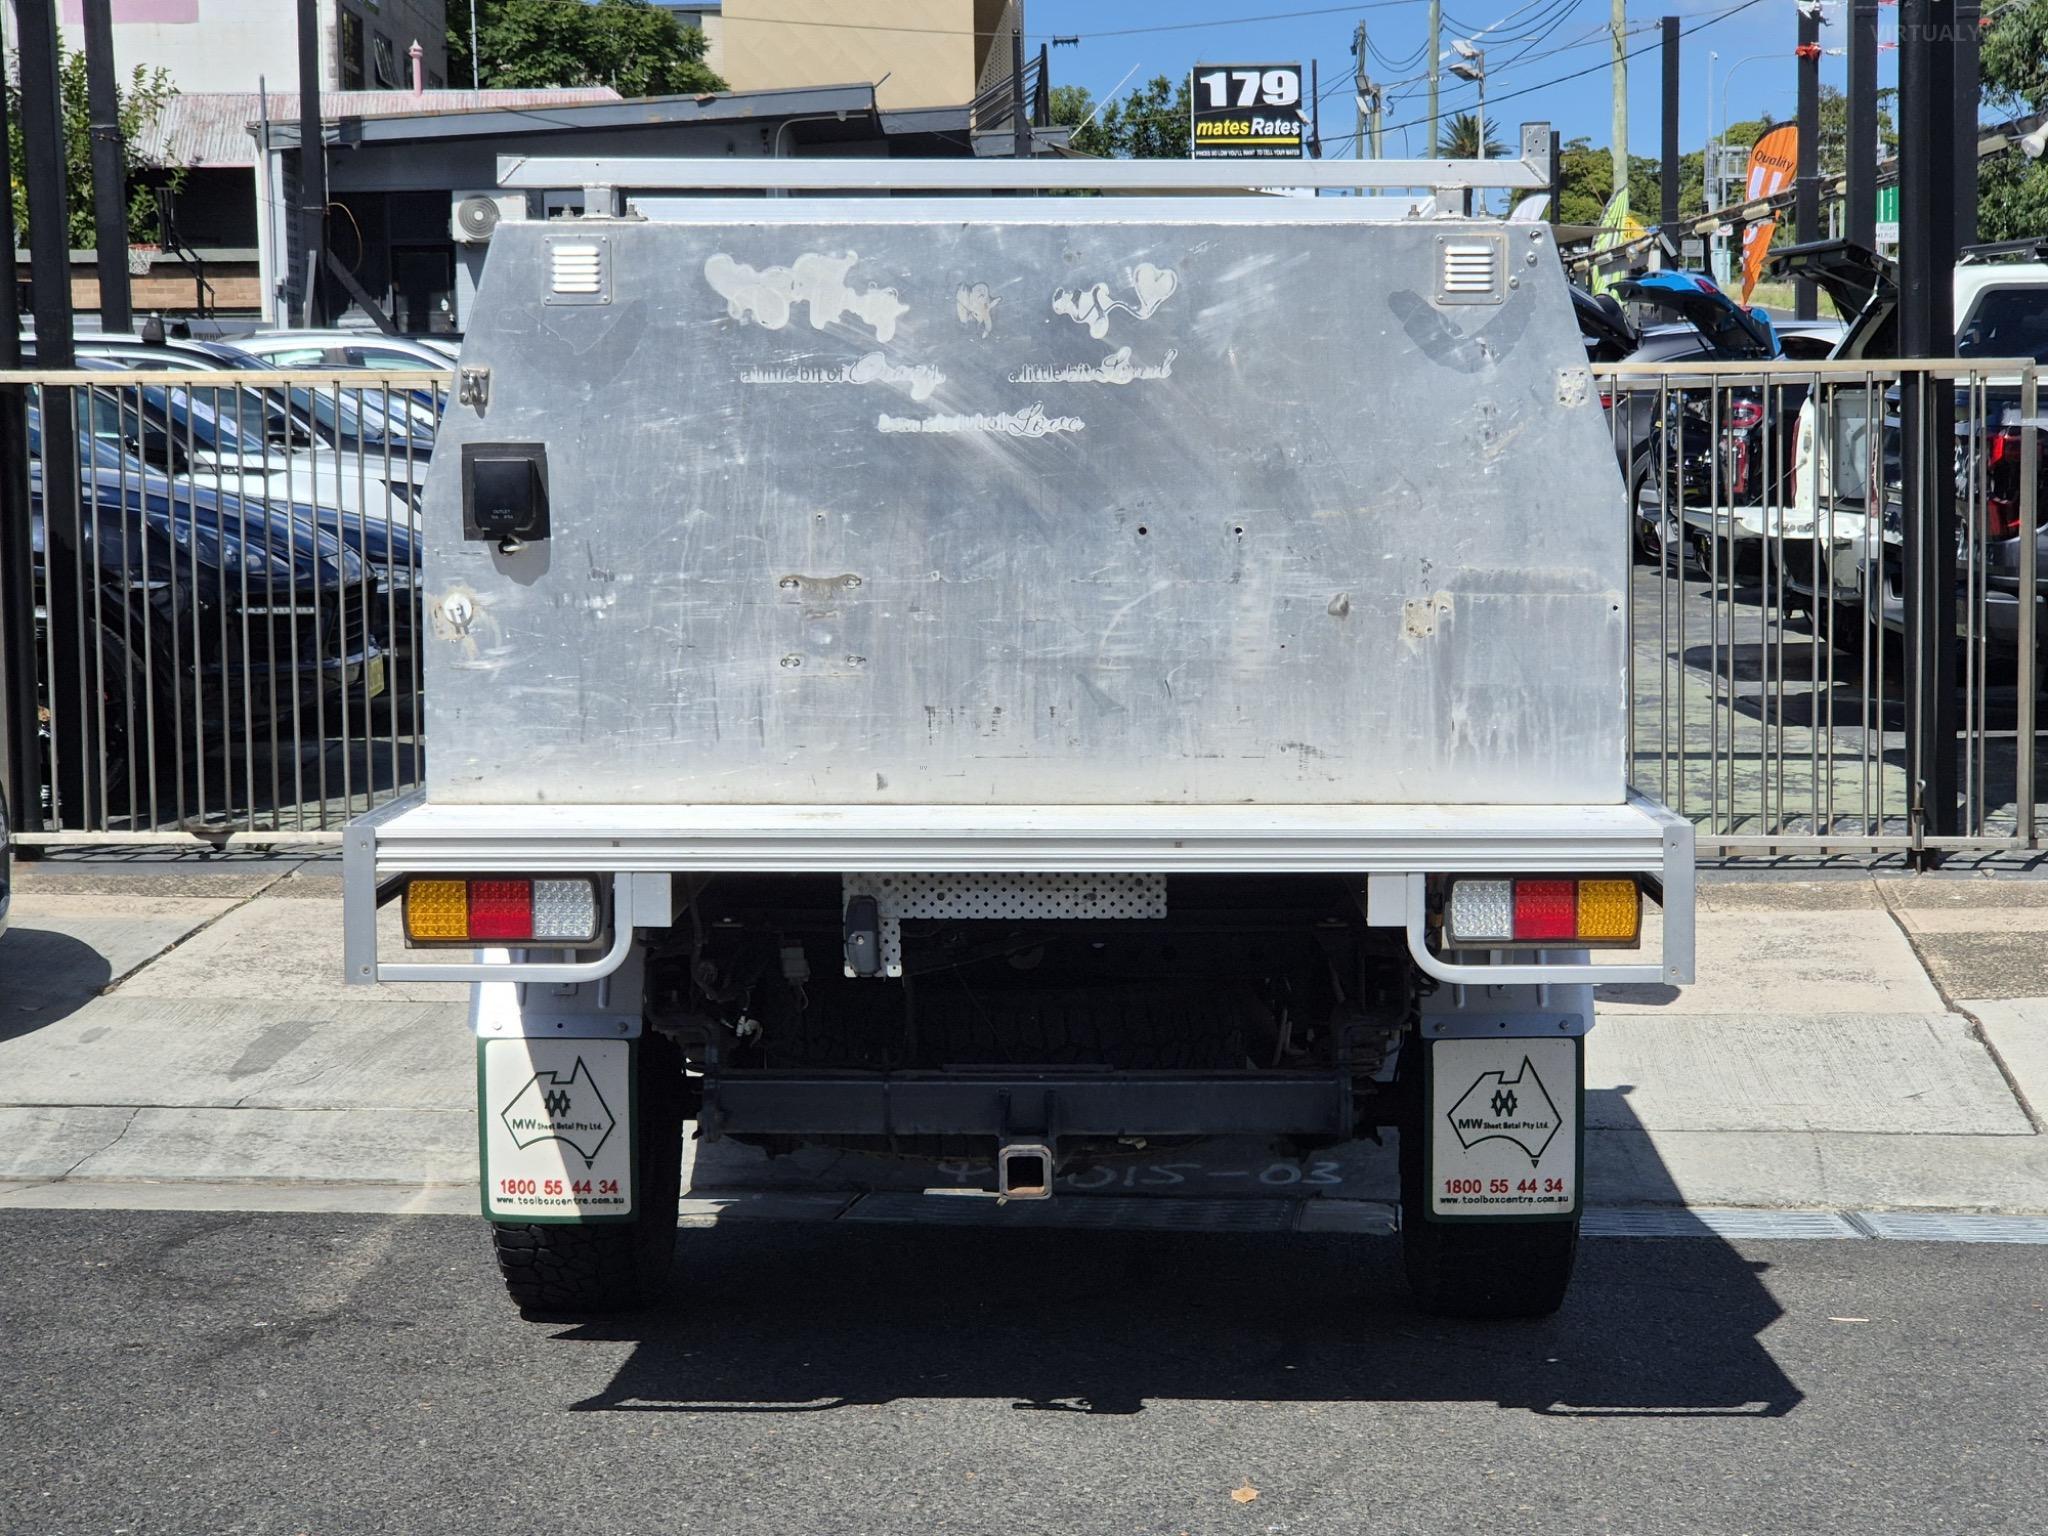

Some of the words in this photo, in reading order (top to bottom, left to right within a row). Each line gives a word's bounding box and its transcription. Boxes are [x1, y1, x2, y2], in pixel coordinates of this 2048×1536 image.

[1200, 70, 1299, 107] 179
[1754, 149, 1794, 172] Quality
[512, 1118, 537, 1130] MW
[576, 1122, 587, 1131] Pty
[589, 1122, 603, 1130] Ltd.
[1458, 1118, 1483, 1129] MW
[1523, 1121, 1534, 1130] Pty
[1536, 1121, 1549, 1129] Ltd.
[500, 1179, 536, 1195] 1800
[544, 1180, 563, 1195] 55
[571, 1179, 593, 1195] 44
[598, 1179, 618, 1195] 34
[1445, 1179, 1482, 1194] 1800
[1489, 1179, 1509, 1194] 55
[1517, 1178, 1538, 1194] 44
[1544, 1178, 1563, 1193] 34
[497, 1196, 625, 1205] www.toolboxcentre.com.au
[1440, 1195, 1569, 1204] www.toolboxcentre.com.au
